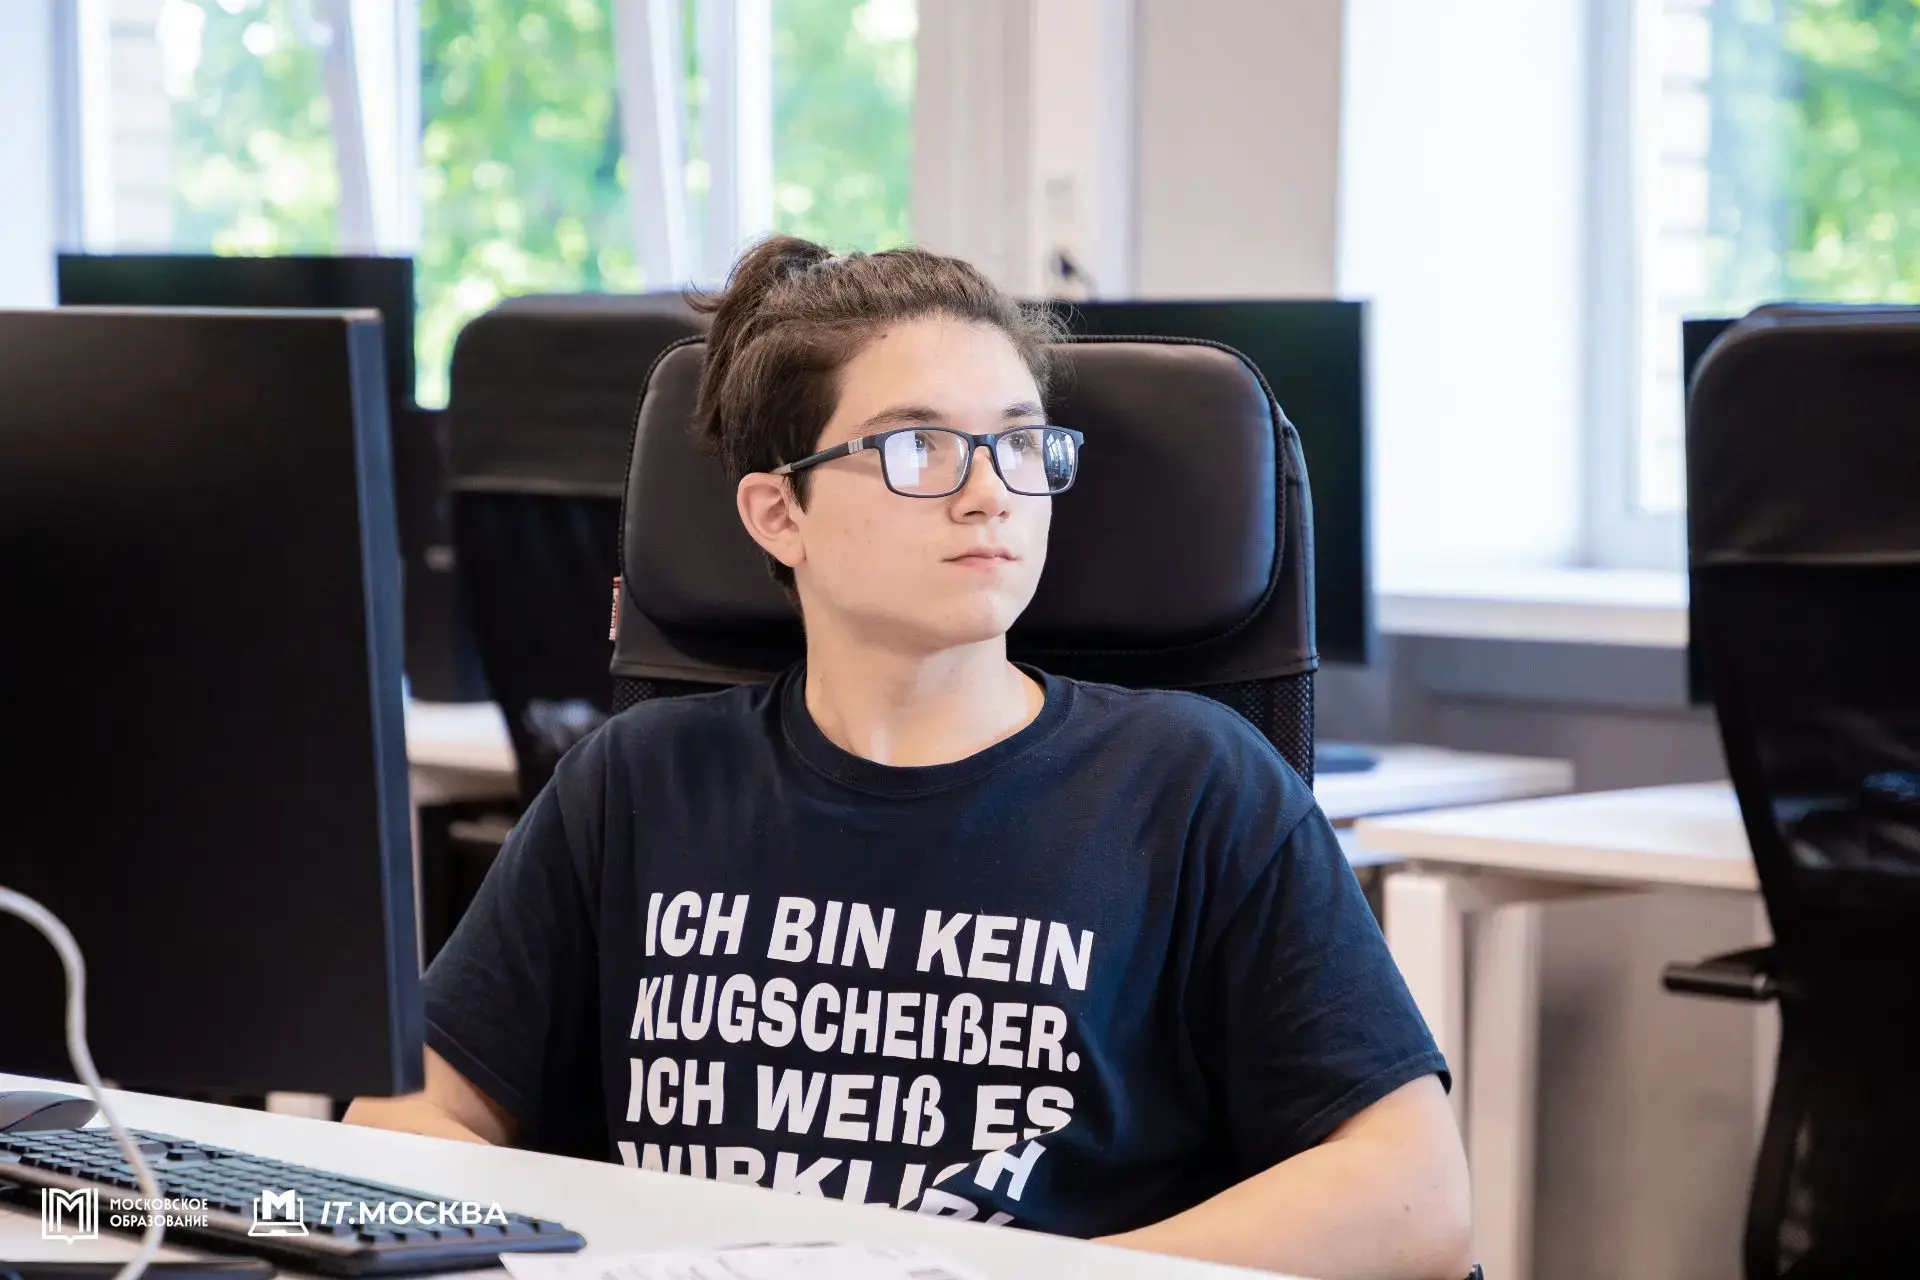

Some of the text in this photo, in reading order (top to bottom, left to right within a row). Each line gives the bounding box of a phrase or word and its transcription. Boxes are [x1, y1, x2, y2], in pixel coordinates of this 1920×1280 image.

[645, 890, 1094, 990] ICH BIN KEIN
[630, 974, 1081, 1072] KLUGSCHEIßER.
[626, 1057, 1074, 1151] ICH WEIß ES
[617, 1141, 1047, 1209] IRKLIH
